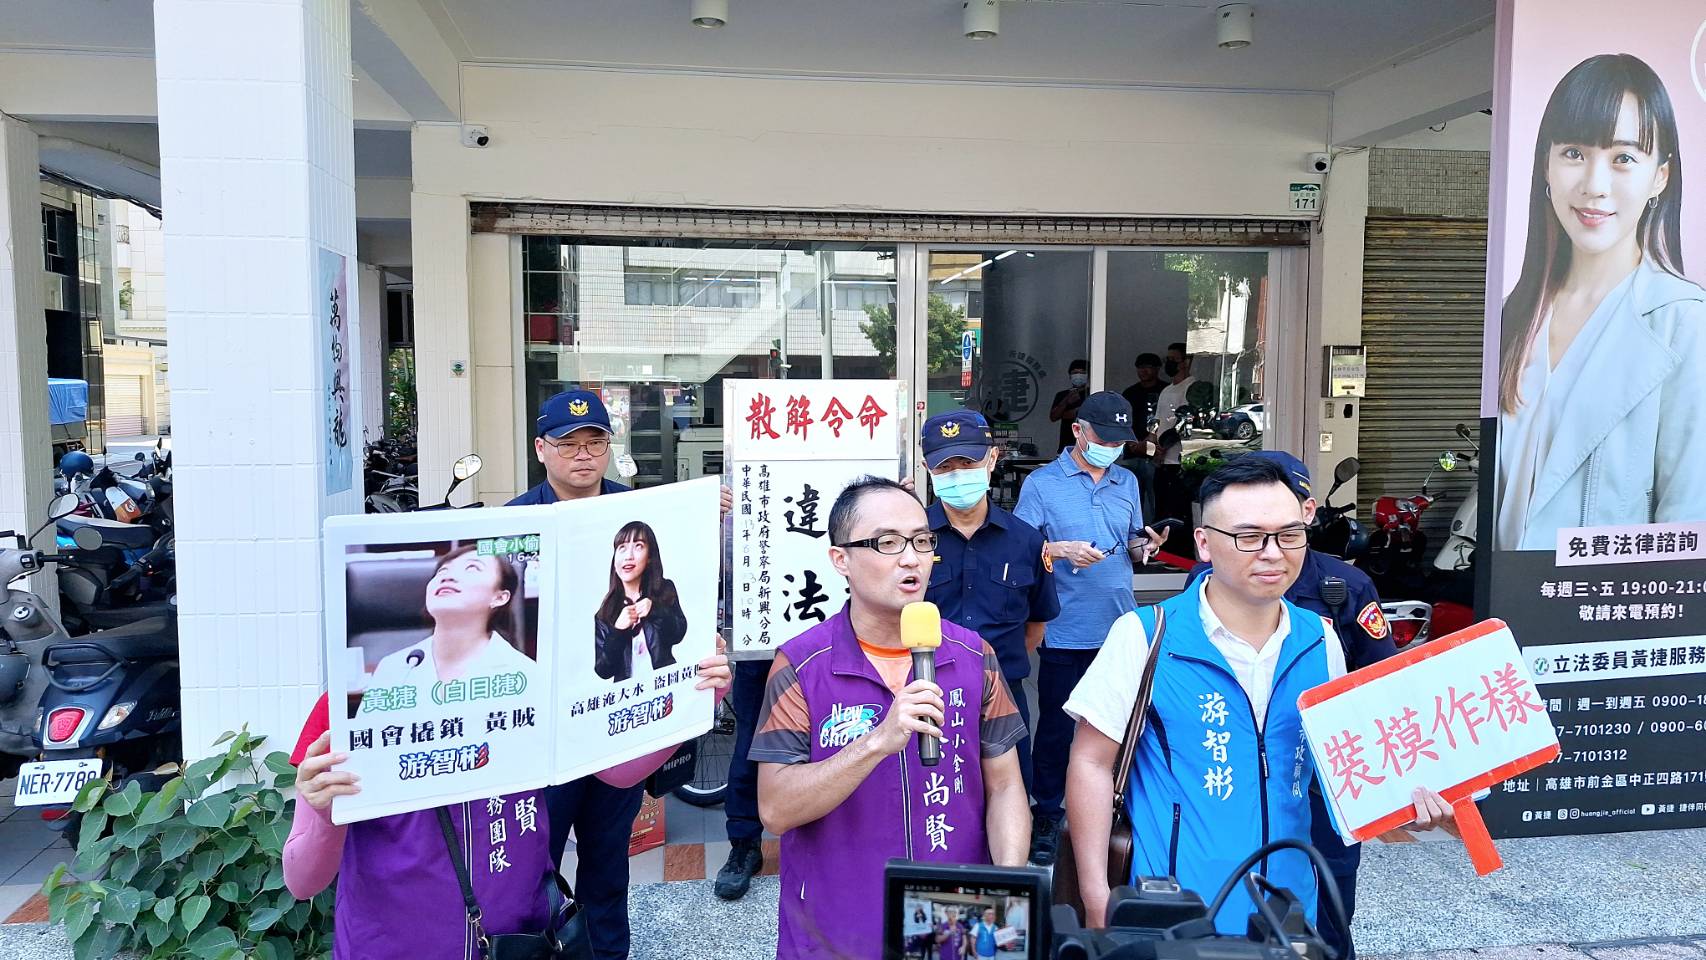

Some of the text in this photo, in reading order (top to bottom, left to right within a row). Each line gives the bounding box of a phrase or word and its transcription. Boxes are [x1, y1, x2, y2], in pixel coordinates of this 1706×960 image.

[1295, 198, 1316, 209] 171
[477, 535, 540, 556] 國會小偷
[758, 464, 771, 645] 高雄市政府警察局新興分局
[783, 484, 829, 623] 違法
[1568, 531, 1698, 558] 免費法律諮詢
[1540, 580, 1615, 598] 每週三、五
[1553, 645, 1706, 674] 立法委員黃捷服務
[570, 682, 645, 718] 高雄淹大水
[831, 702, 864, 723] New
[1577, 695, 1646, 712] 週一到週五
[485, 706, 536, 735] 黃賊
[608, 692, 674, 736] 游智彬
[949, 688, 966, 794] 鳳山小金剛
[1324, 662, 1545, 801] 裝模作樣
[1556, 722, 1631, 737] 7-7101230
[1198, 691, 1234, 801] 游智彬
[1549, 748, 1627, 764] 7-7101312
[400, 742, 490, 780] 游智彬
[662, 753, 692, 773] MIPRO
[1503, 770, 1706, 793] 地址 高雄市前金區中正四路171
[515, 796, 538, 836] 賢
[1534, 810, 1551, 821] 黃捷
[1581, 808, 1636, 818] huangjie_official
[1679, 802, 1706, 812] 捷伴同
[486, 794, 512, 873] 務團隊
